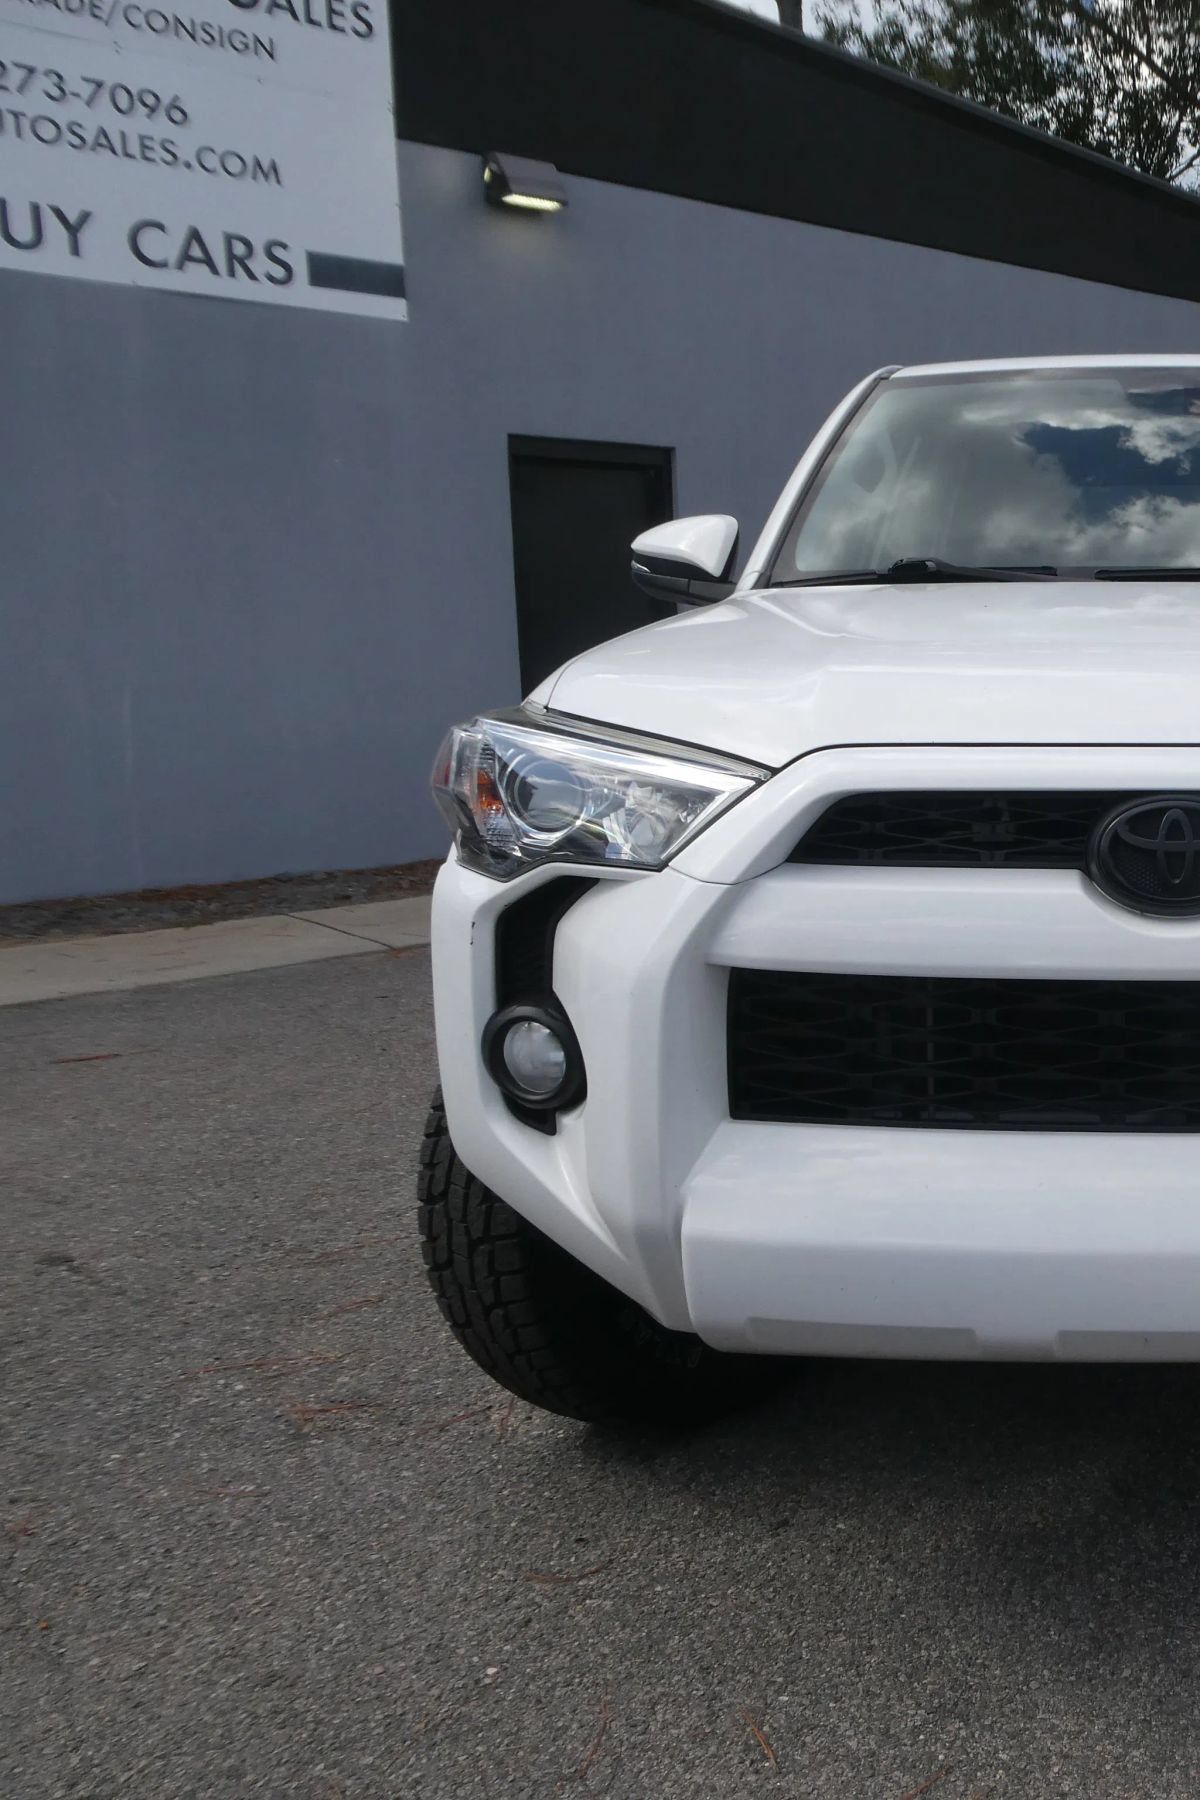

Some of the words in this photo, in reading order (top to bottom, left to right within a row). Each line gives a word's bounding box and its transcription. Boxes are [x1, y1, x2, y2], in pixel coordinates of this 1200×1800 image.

[228, 0, 374, 38] ALES
[0, 108, 281, 186] TOSALES.COM
[127, 218, 294, 286] CARS
